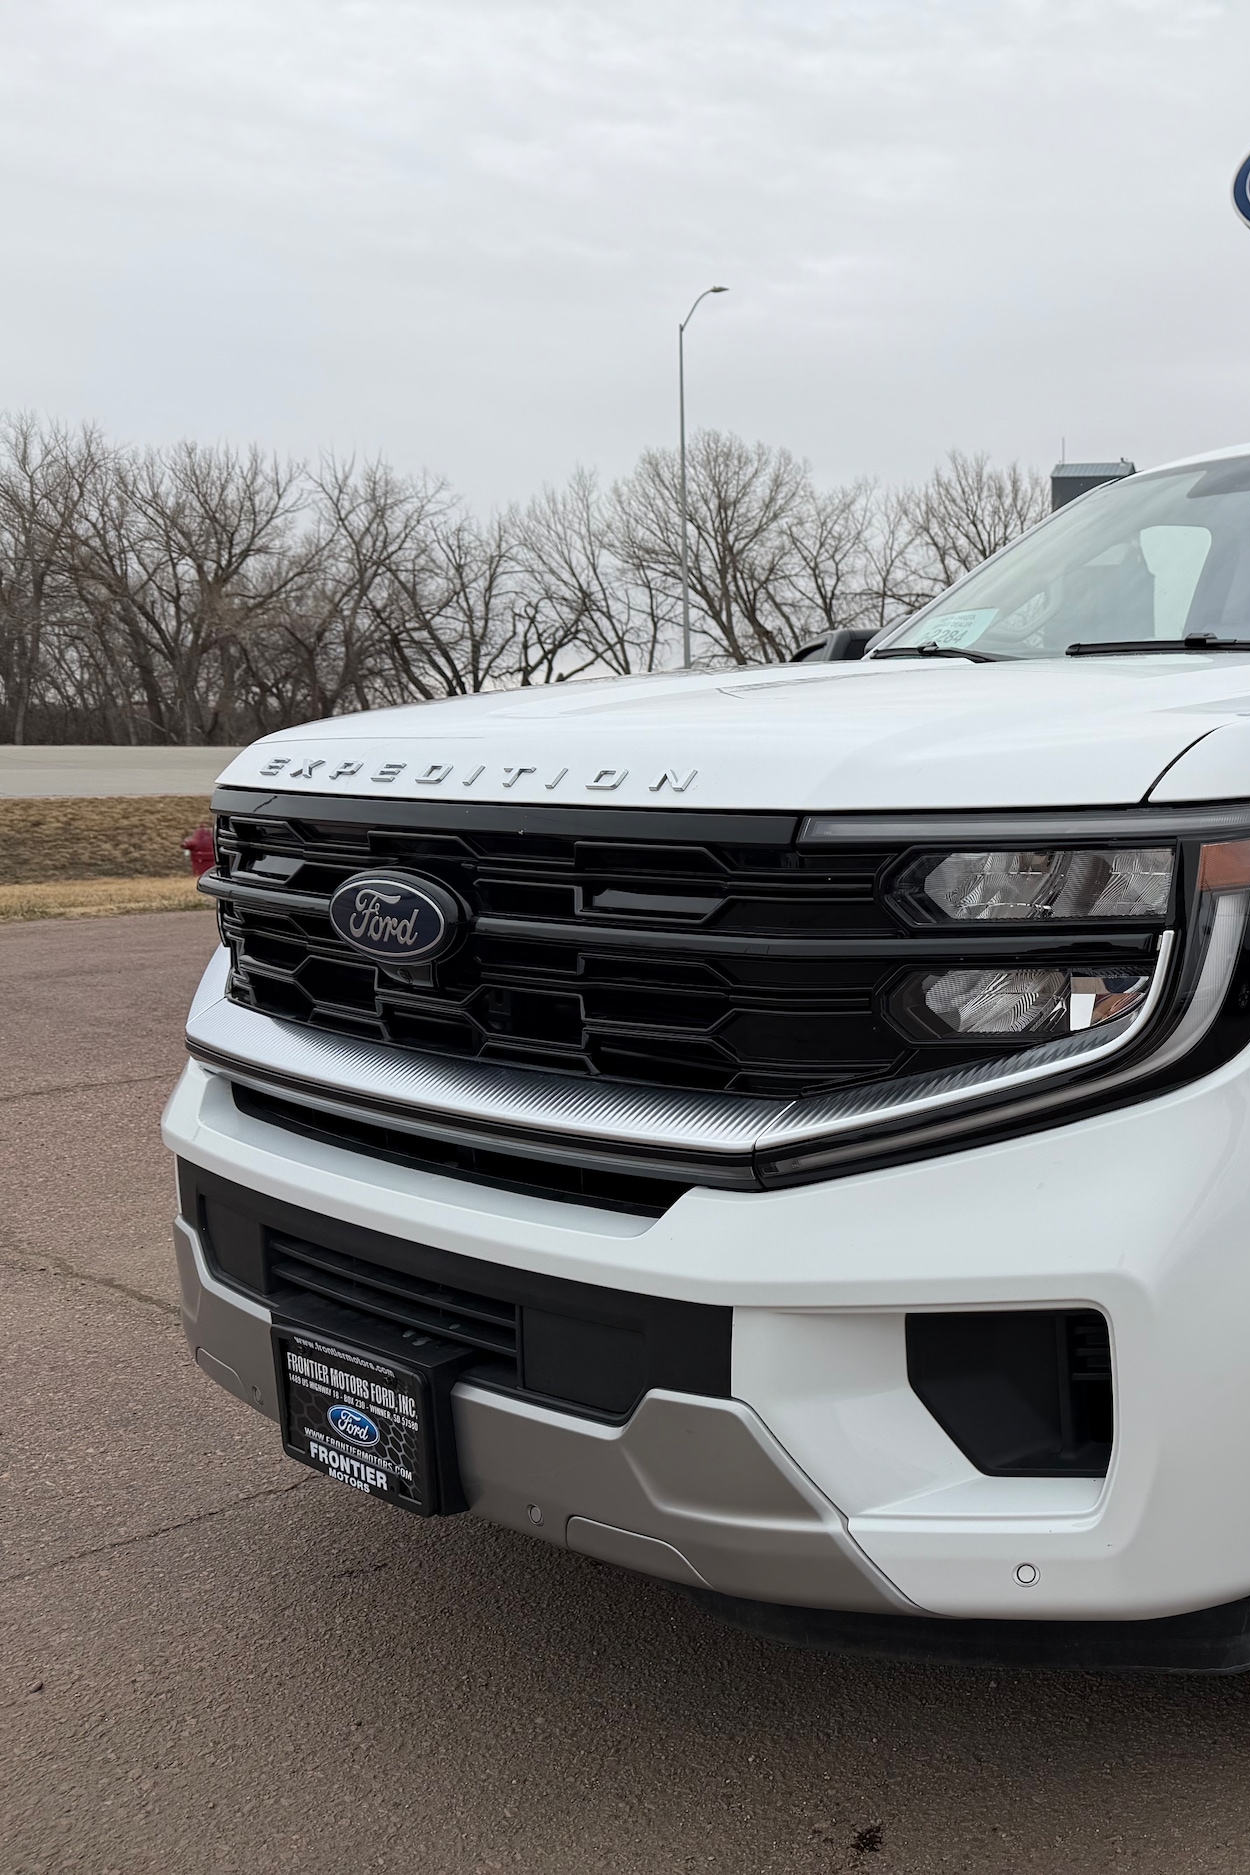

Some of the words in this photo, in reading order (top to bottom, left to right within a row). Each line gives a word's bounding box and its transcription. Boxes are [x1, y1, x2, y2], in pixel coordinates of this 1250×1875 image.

[258, 756, 698, 793] EXPEDITION
[349, 888, 420, 947] Ford
[287, 1352, 329, 1385] FRONTIER
[330, 1367, 370, 1399] MOTORS
[302, 1378, 309, 1387] US
[333, 1390, 339, 1399] 18
[344, 1394, 354, 1405] BOX
[393, 1414, 401, 1424] SD
[338, 1410, 368, 1440] Ford
[304, 1427, 412, 1481] WWWFRONTIERMOTORSCOM
[309, 1441, 388, 1491] FRONTIER
[328, 1467, 370, 1493] MOTORS
